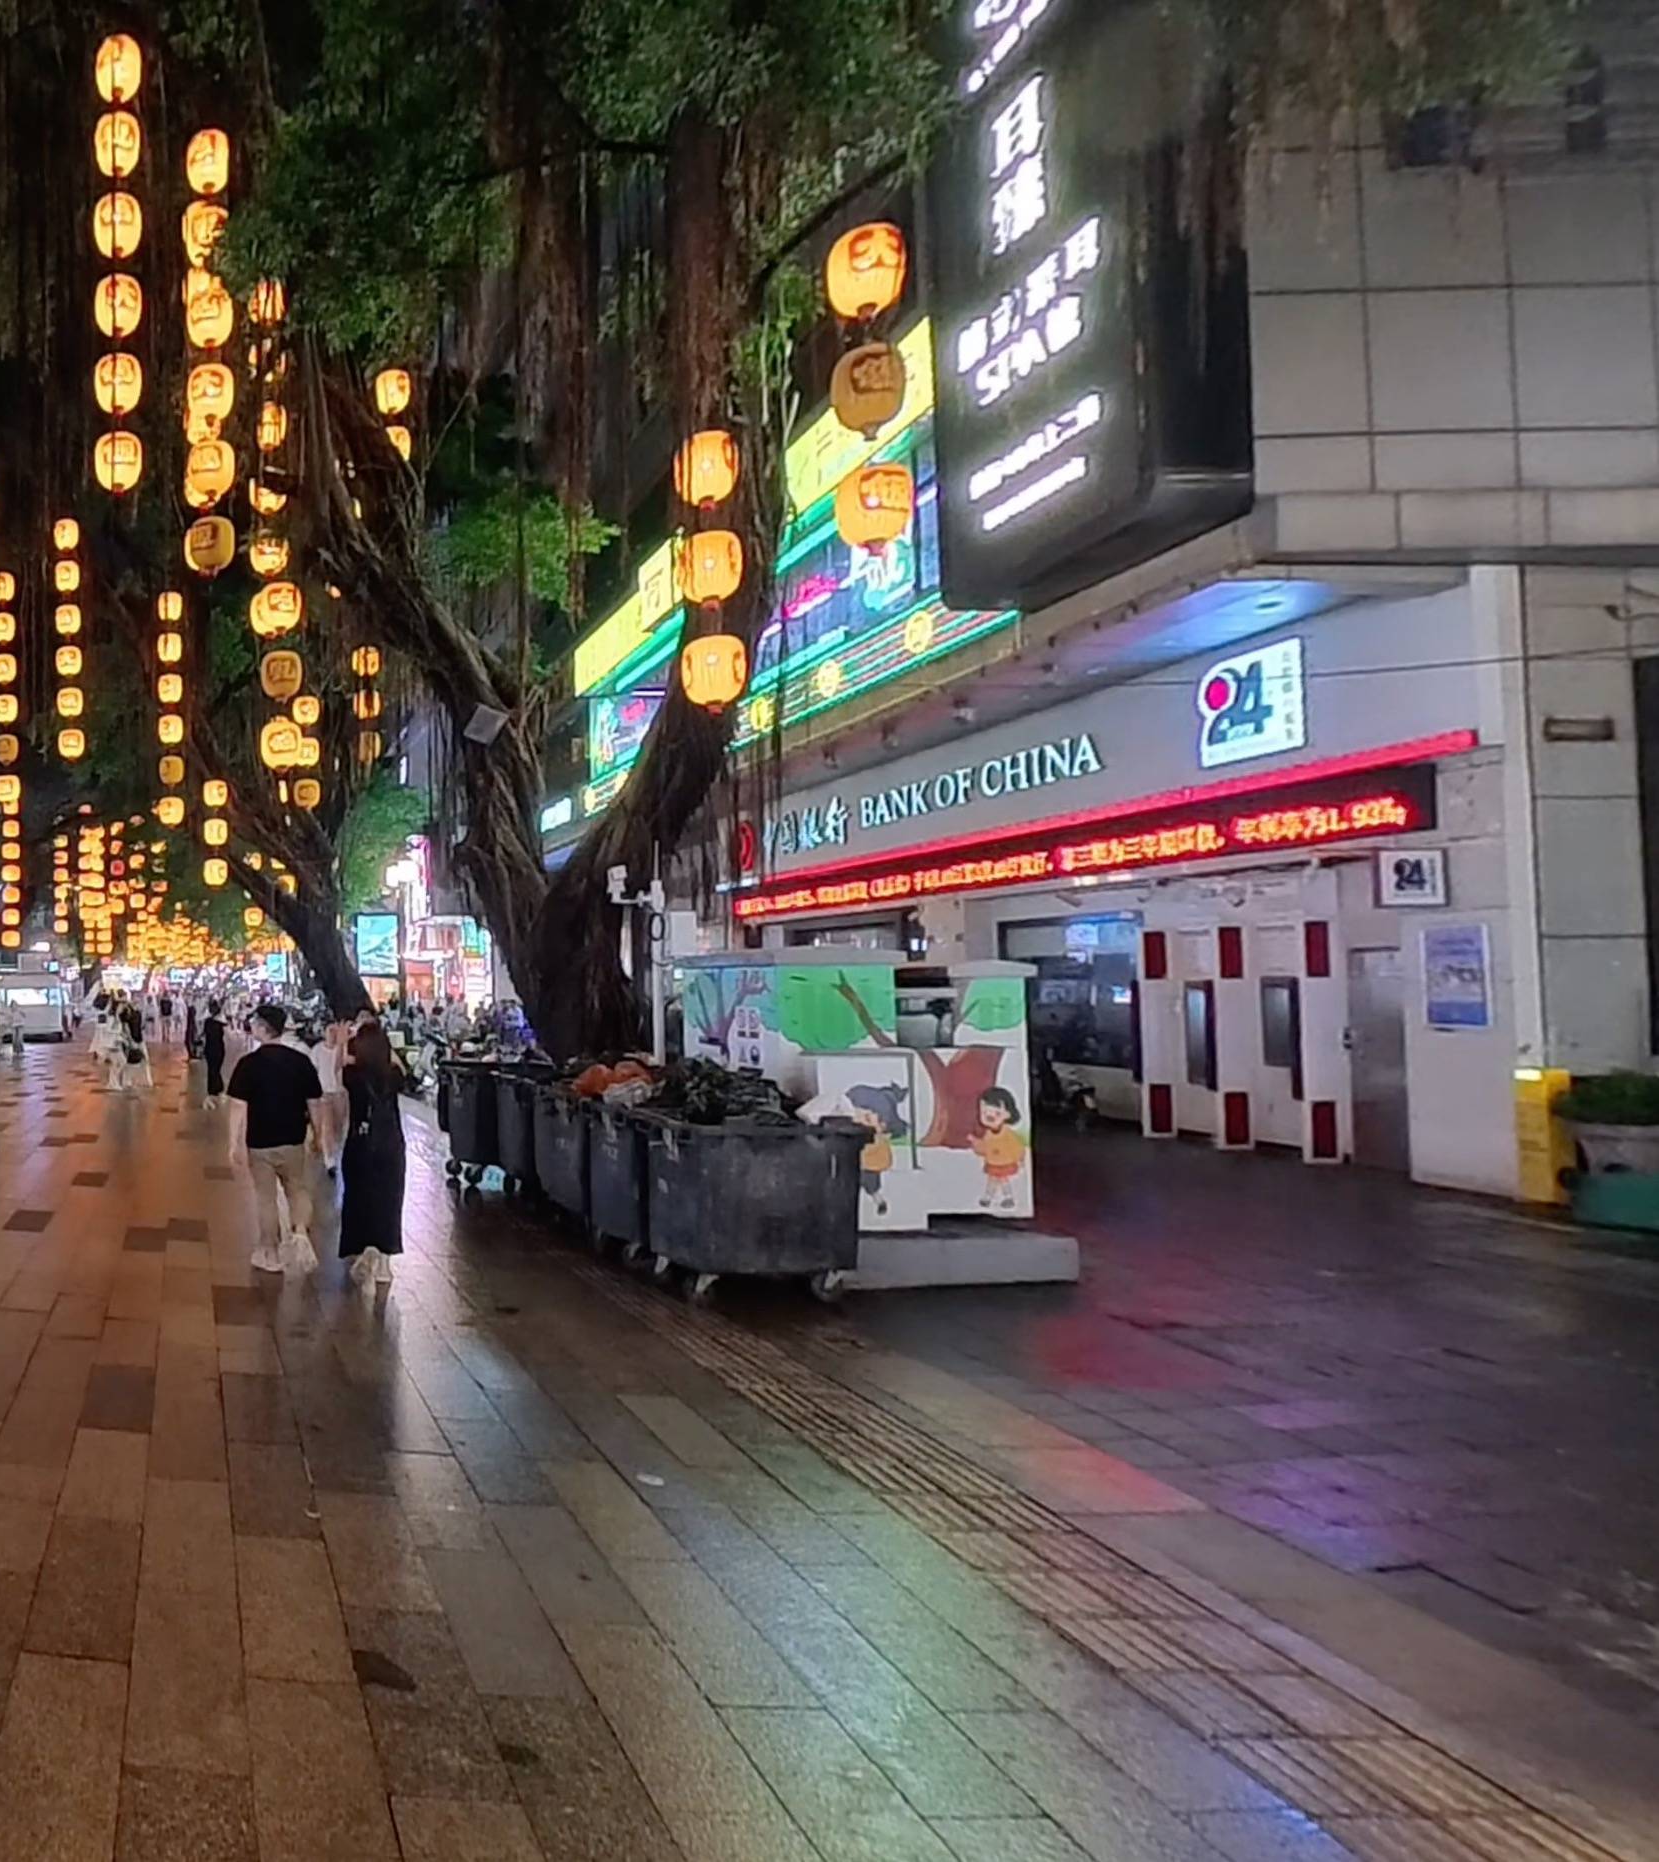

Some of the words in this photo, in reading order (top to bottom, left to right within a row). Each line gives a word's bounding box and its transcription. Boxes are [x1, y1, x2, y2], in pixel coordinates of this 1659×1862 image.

[1205, 659, 1274, 747] 24
[860, 781, 931, 829] BANK
[934, 766, 975, 809] OF
[980, 733, 1102, 797] CHINA
[1393, 858, 1426, 892] 24
